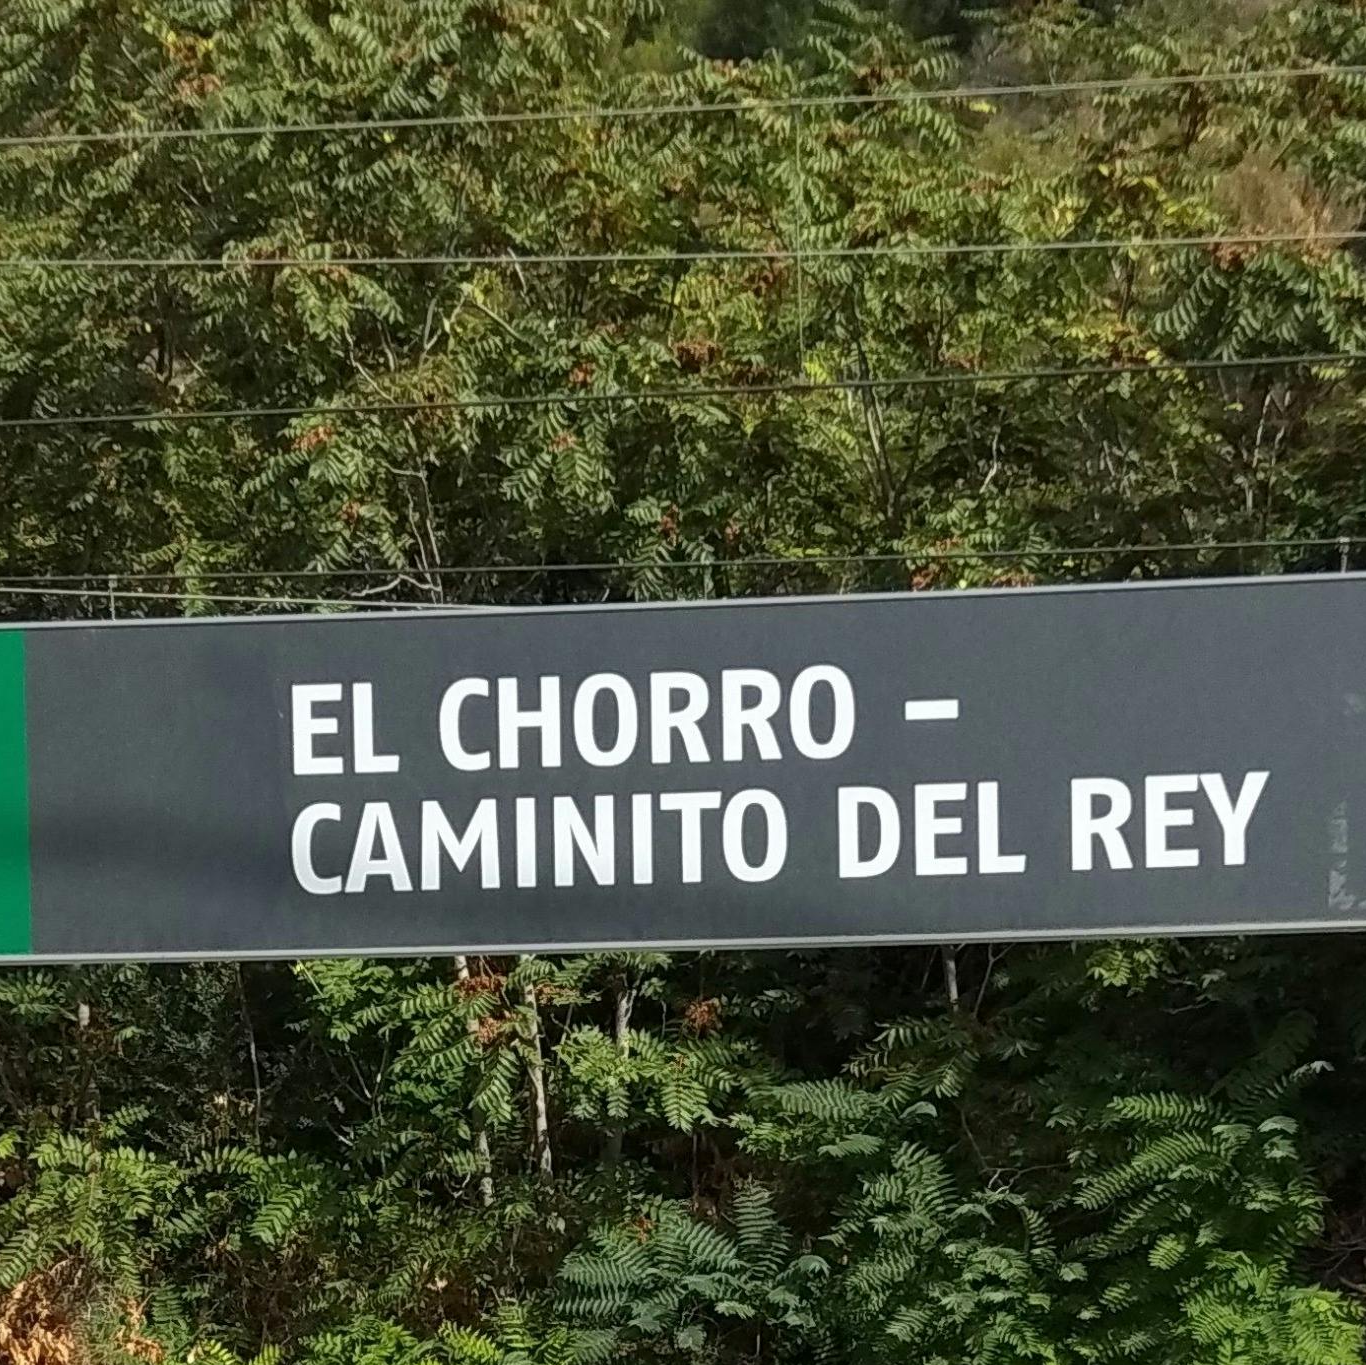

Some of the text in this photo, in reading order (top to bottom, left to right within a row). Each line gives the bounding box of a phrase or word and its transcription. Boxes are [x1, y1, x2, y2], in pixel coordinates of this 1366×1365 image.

[292, 682, 400, 775] EL
[439, 665, 856, 771] CHORRO
[291, 771, 1271, 894] CAMINITO DEL REY
